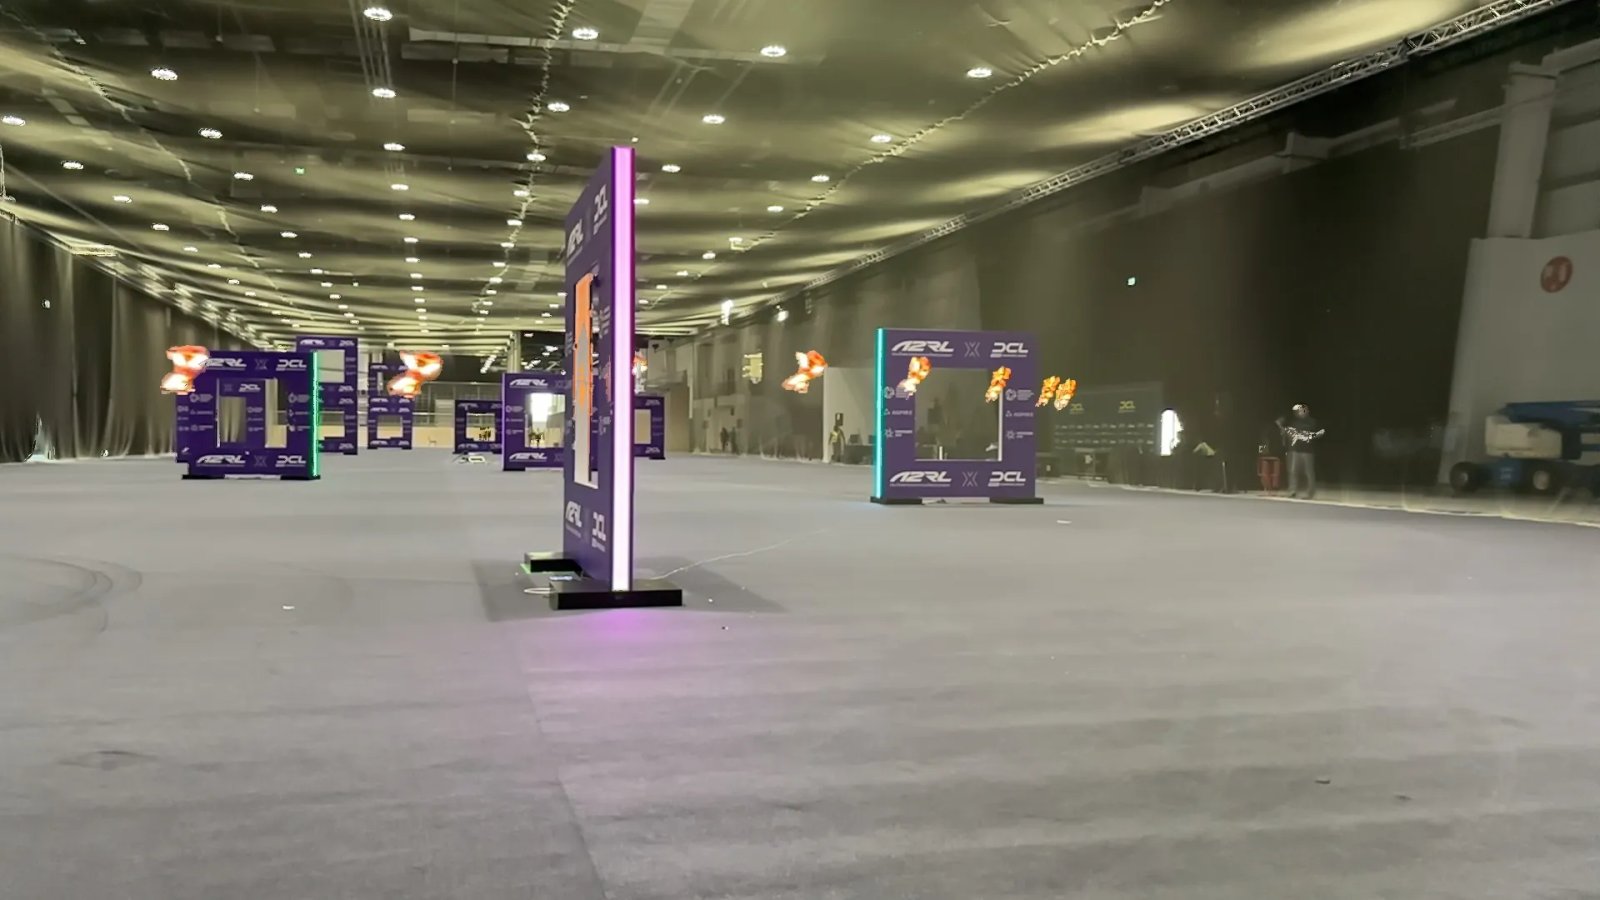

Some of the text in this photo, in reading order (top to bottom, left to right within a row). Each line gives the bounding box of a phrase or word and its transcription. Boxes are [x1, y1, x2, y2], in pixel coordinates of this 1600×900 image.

[891, 340, 954, 352] A2RL
[991, 342, 1029, 353] DCL
[889, 471, 952, 483] A2RL
[989, 471, 1027, 482] DCL
